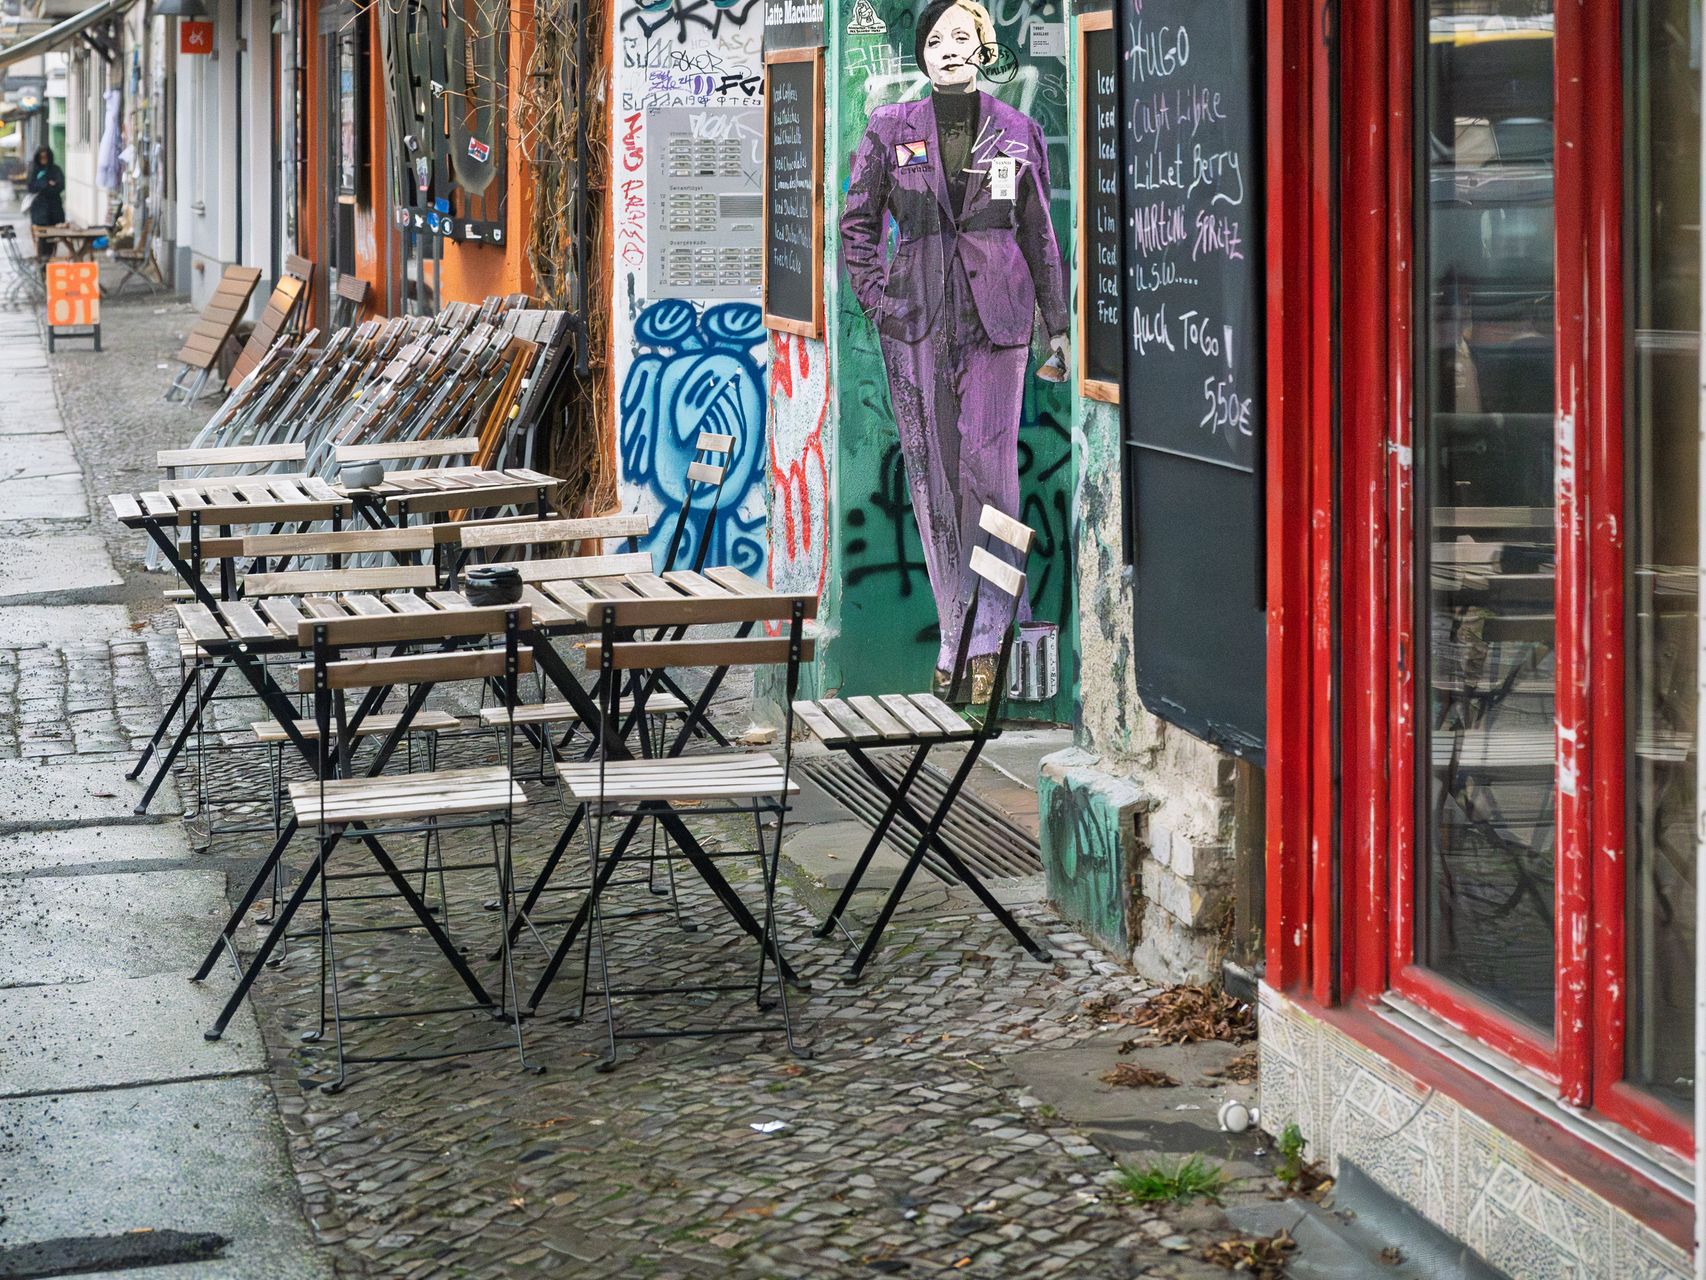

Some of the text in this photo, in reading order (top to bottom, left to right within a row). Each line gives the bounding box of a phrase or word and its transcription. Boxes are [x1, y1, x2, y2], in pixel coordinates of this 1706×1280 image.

[765, 2, 783, 26] Latte
[1098, 69, 1115, 95] Iced
[1098, 104, 1115, 131] Iced
[1098, 136, 1116, 159] Iced
[1098, 168, 1116, 195] Iced
[1098, 242, 1117, 265] Iced
[1099, 273, 1118, 297] Iced
[1200, 375, 1253, 436] 5,50€
